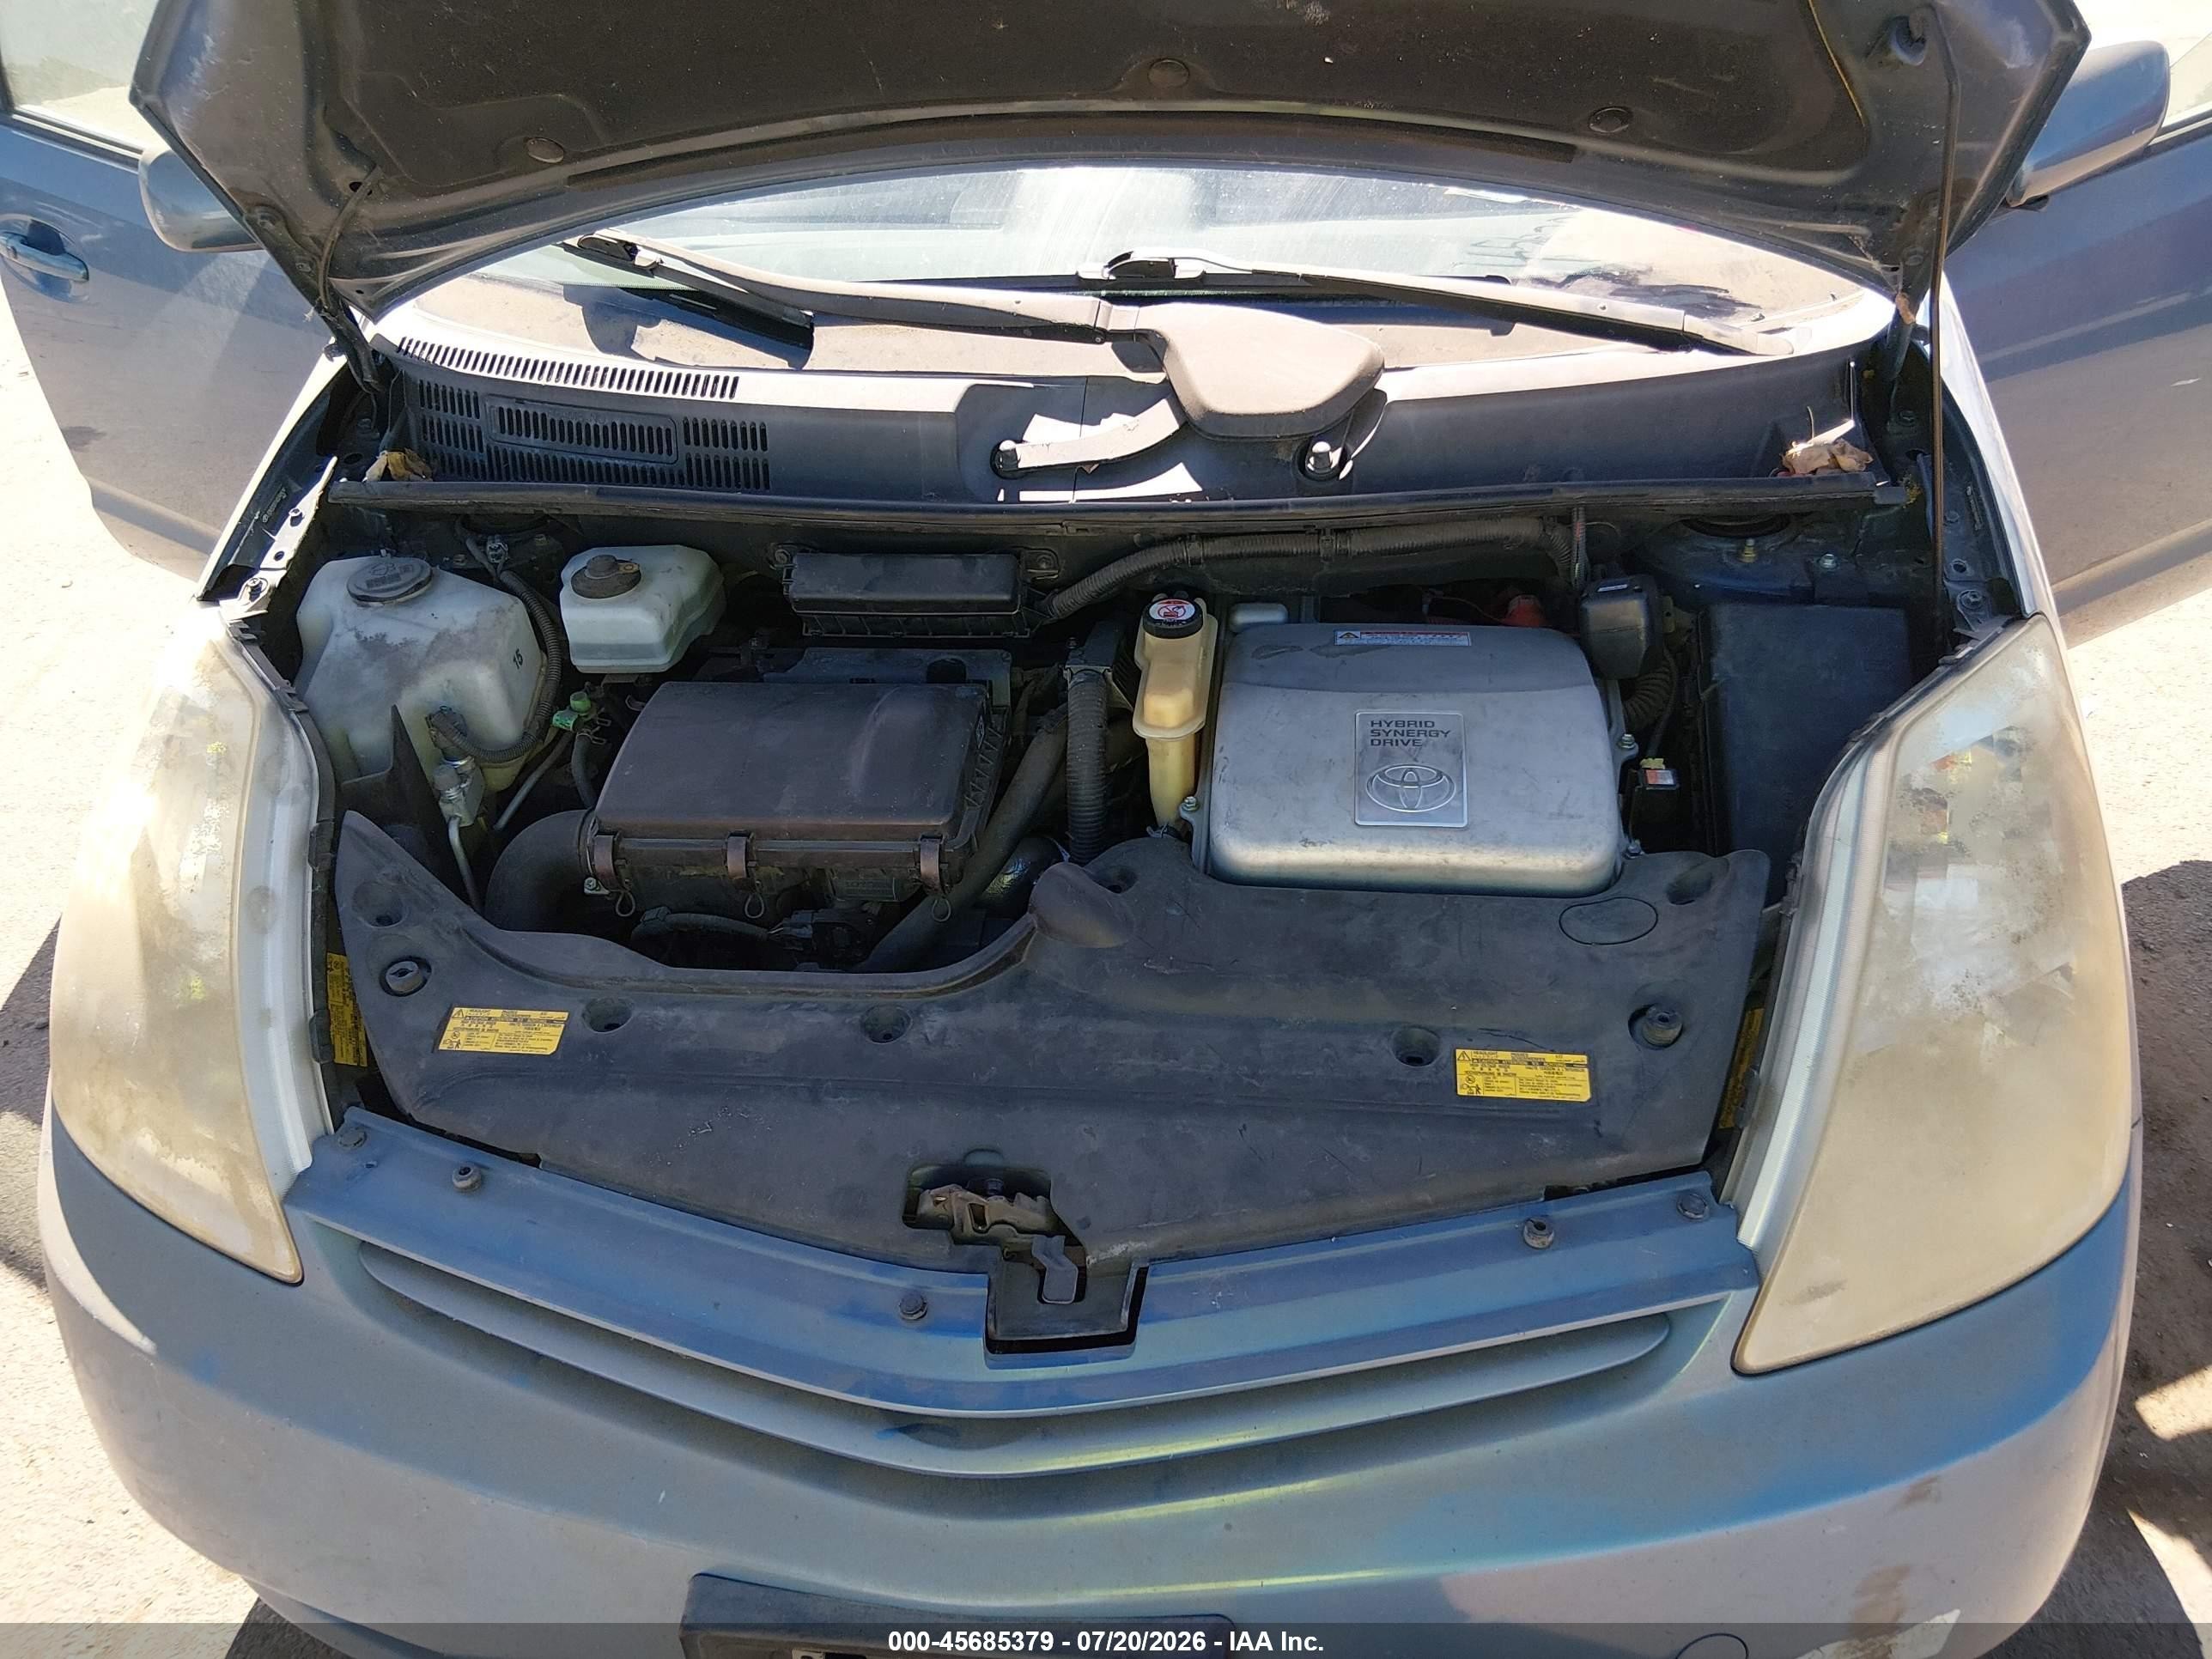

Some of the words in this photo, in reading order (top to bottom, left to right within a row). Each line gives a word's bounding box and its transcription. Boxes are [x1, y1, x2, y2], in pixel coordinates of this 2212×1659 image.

[1370, 720, 1435, 728] HYBRID
[1370, 729, 1450, 738] SYNERGY
[1370, 738, 1423, 747] DRIVE
